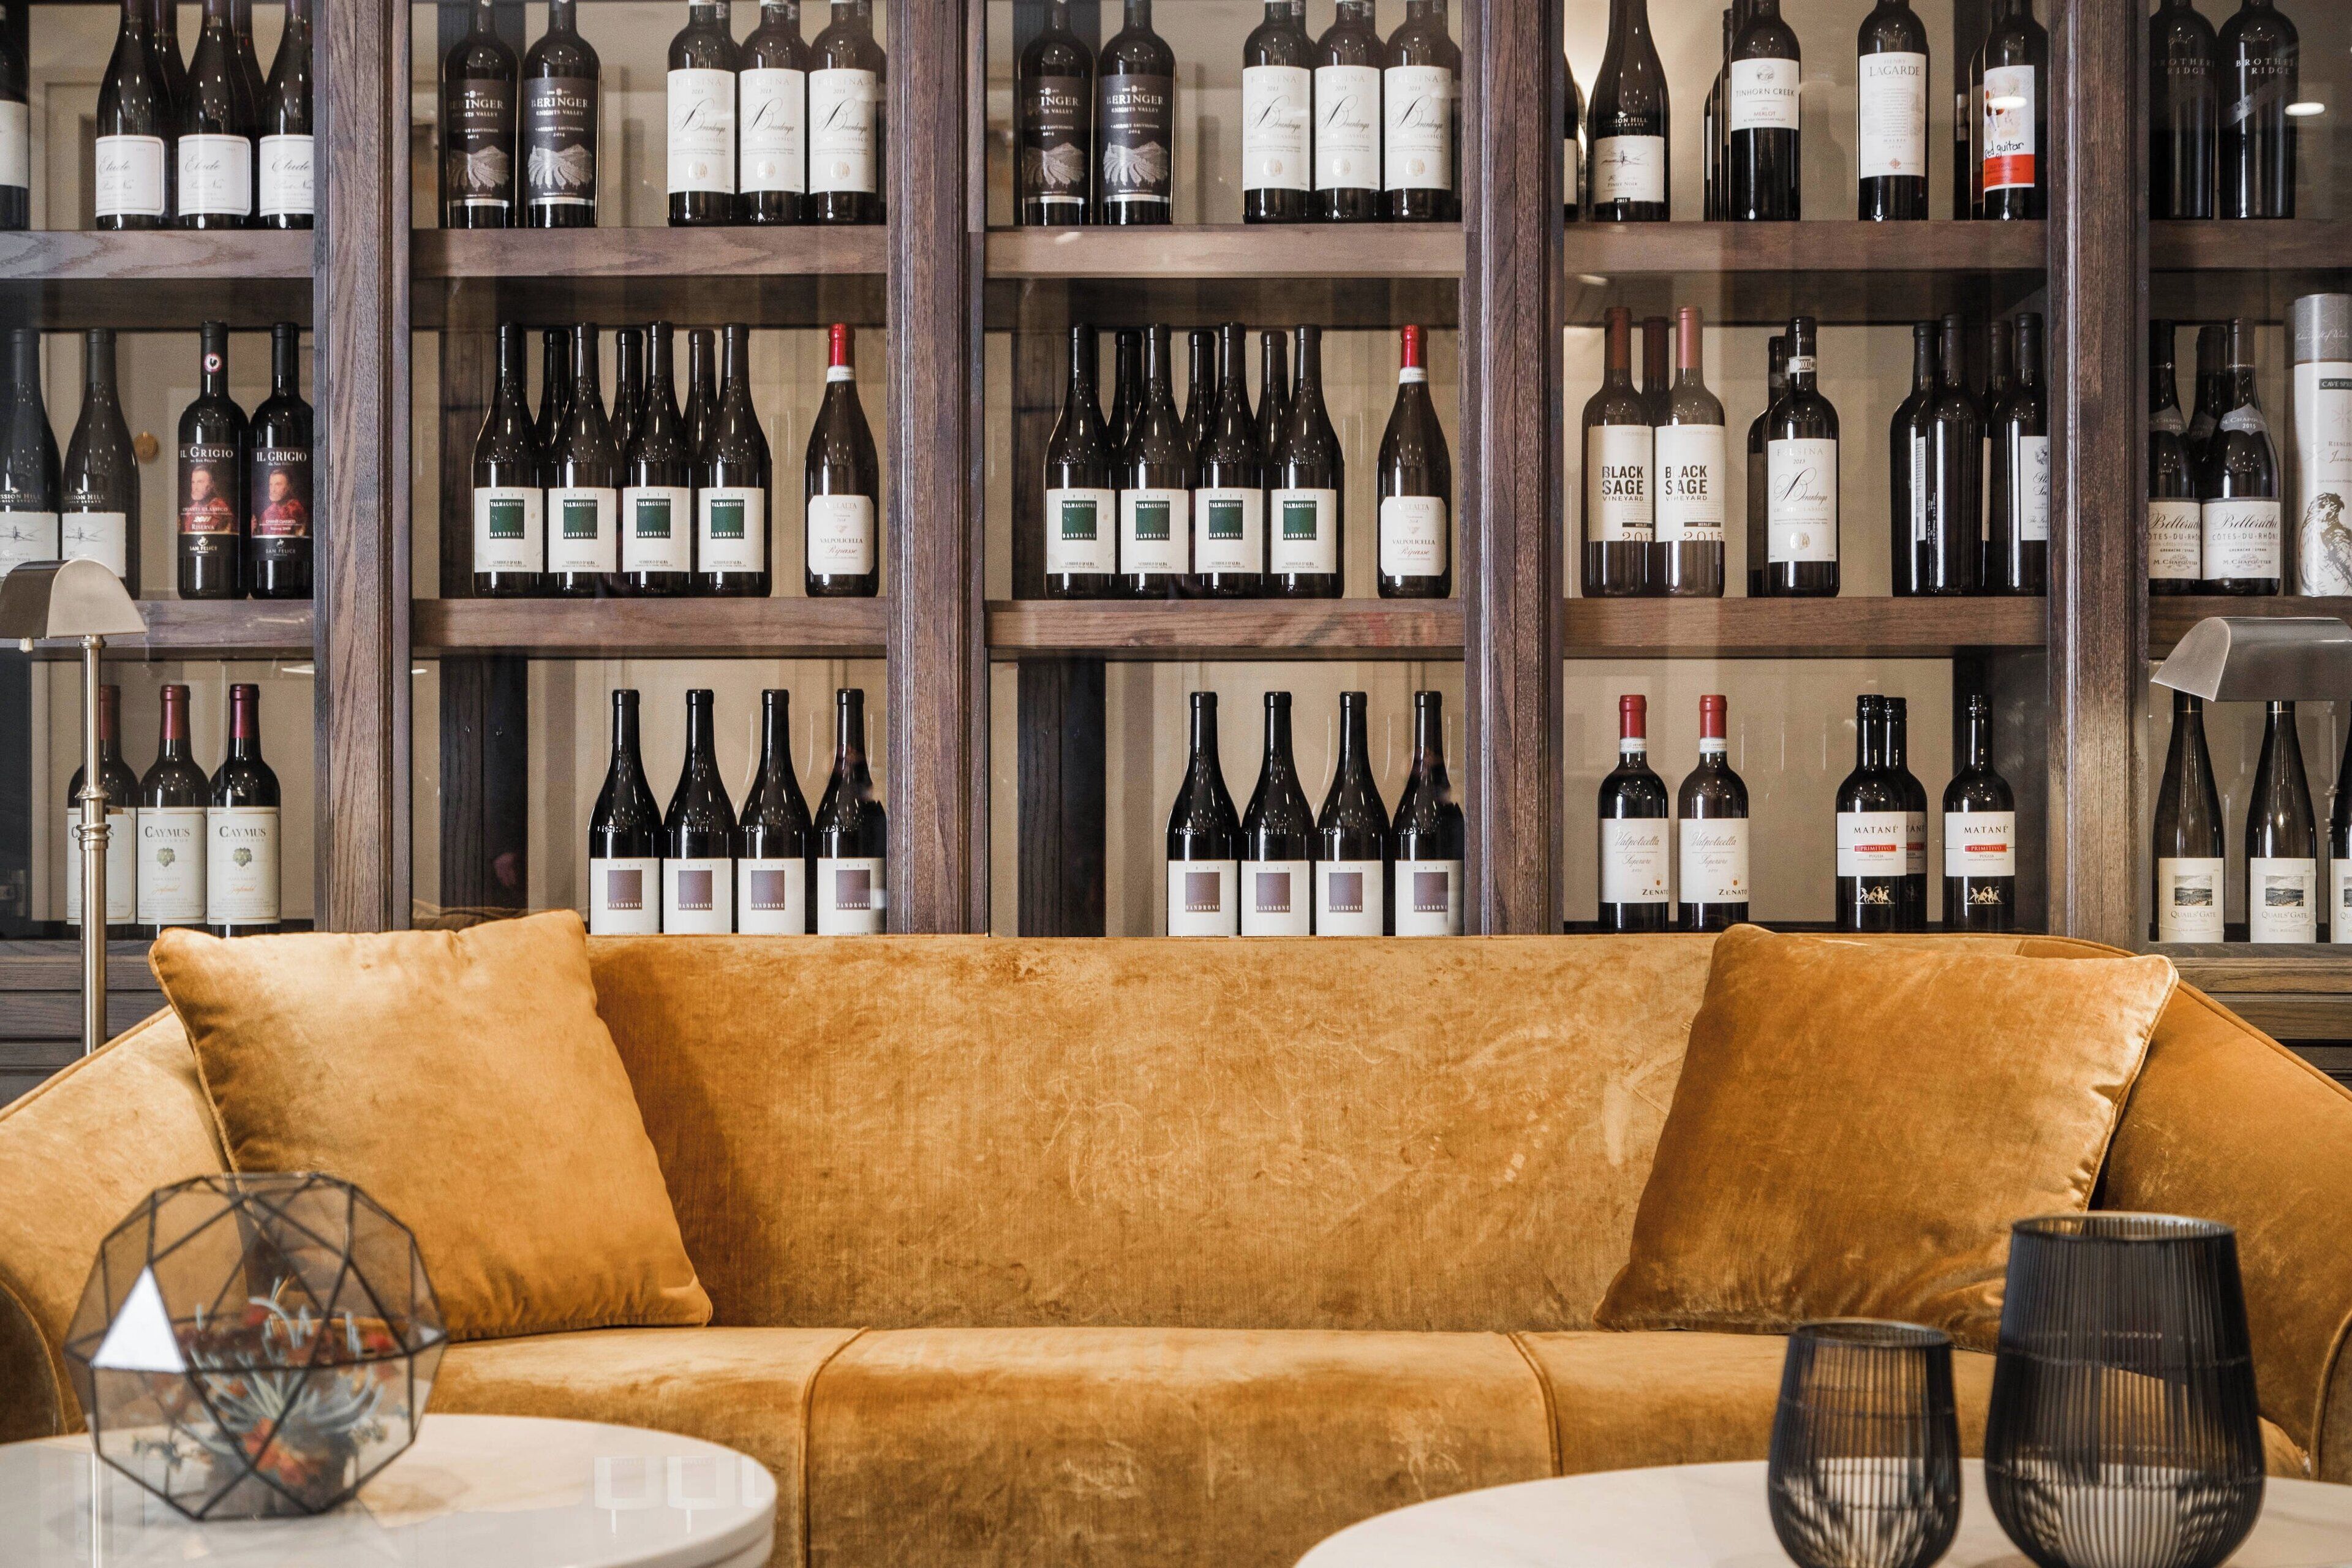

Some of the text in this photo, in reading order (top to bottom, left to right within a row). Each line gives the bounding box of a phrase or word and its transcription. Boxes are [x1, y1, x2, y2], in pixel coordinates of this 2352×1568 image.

[1869, 66, 1920, 77] LAGARDE
[1736, 88, 1795, 97] TINHORN CREEK
[531, 97, 588, 108] BERINGER
[1106, 94, 1164, 105] BERINGER
[1985, 140, 2024, 160] red guitar
[190, 447, 234, 458] GRIGIO
[257, 451, 307, 462] IL GRIGIO
[1602, 466, 1644, 479] BLACK
[1602, 480, 1644, 496] SAGE
[1665, 479, 1708, 496] SAGE
[2212, 511, 2278, 530] Belleruche
[1684, 531, 1723, 542] 2015
[145, 826, 190, 838] CAYMUS
[219, 826, 266, 838] CAYMUS
[1853, 824, 1898, 834] MATANÉ
[1964, 824, 2007, 834] MATANÉ
[1614, 830, 1660, 850] Valpolicella
[1690, 830, 1737, 850] Valpolicella
[1622, 854, 1651, 869] Superiore
[1698, 854, 1728, 869] Superiore
